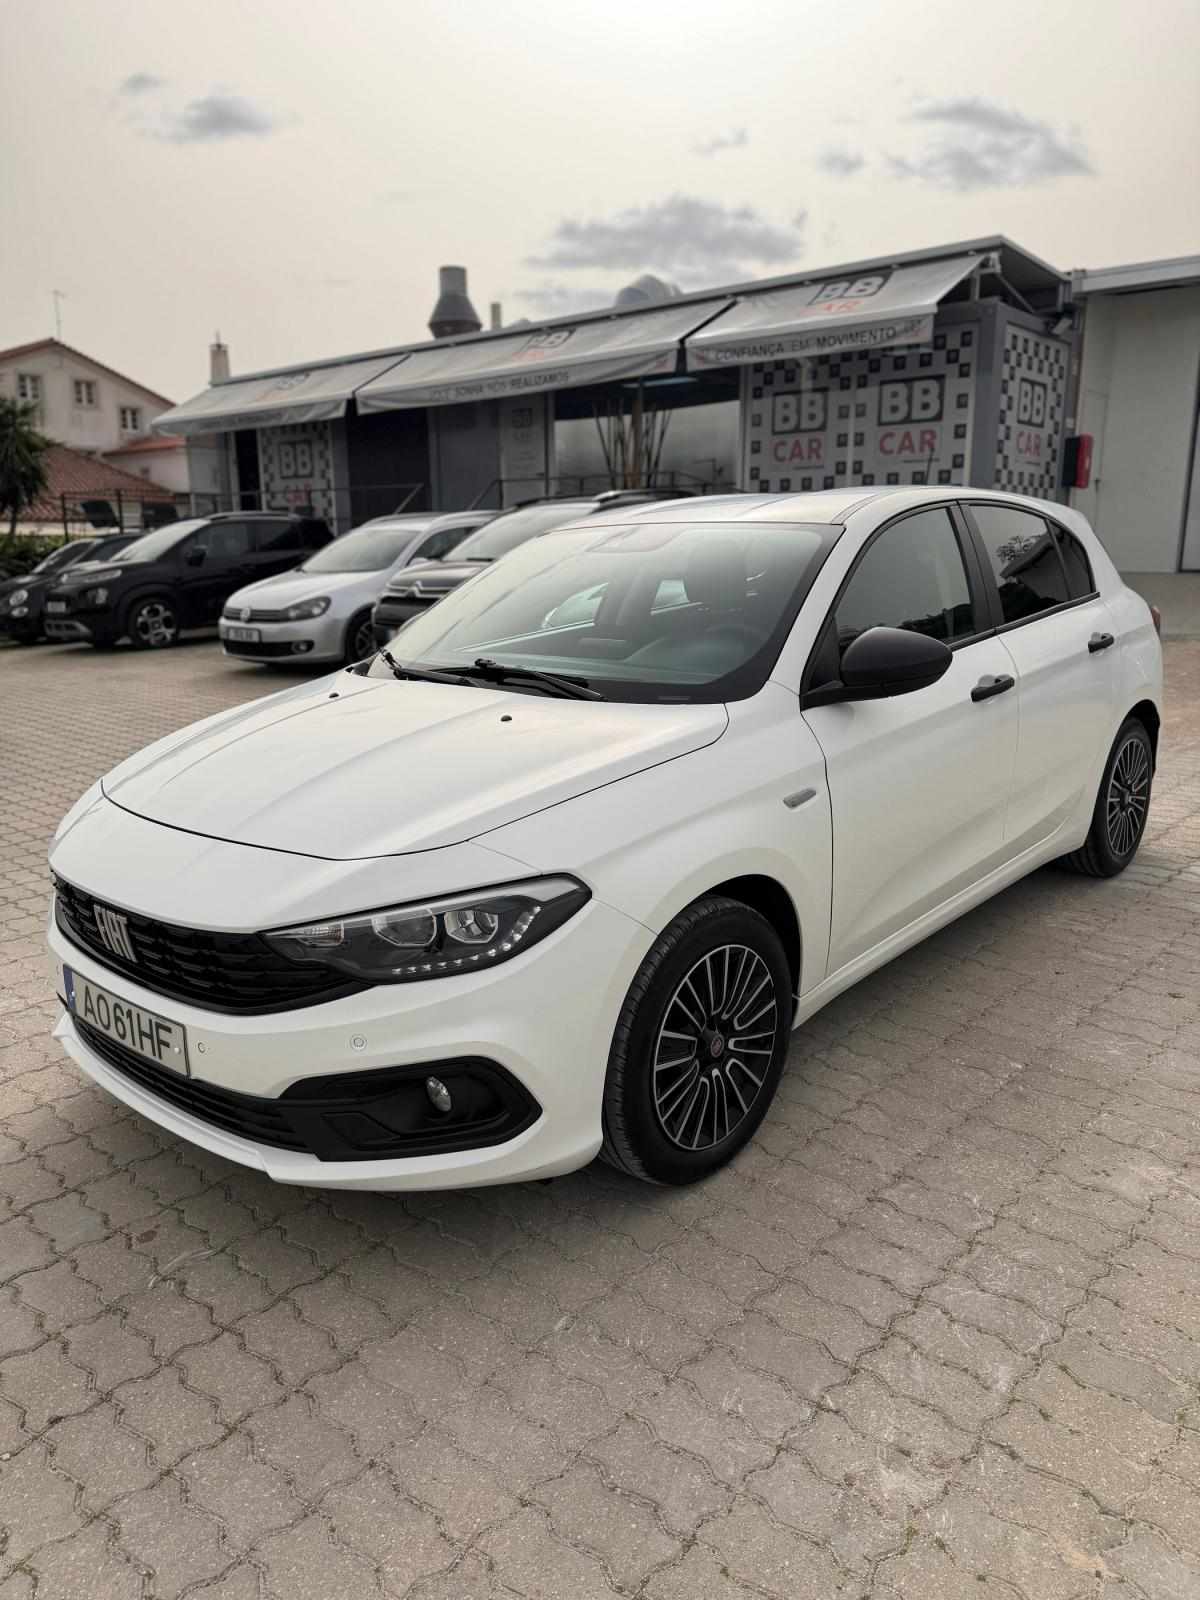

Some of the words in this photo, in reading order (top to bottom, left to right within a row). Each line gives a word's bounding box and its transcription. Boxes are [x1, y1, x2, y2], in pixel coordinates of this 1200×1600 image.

[812, 276, 885, 303] BB
[816, 326, 897, 347] MOVIMENTO
[774, 391, 826, 433] BB
[878, 377, 942, 424] BB
[1019, 381, 1045, 426] BB
[280, 442, 312, 478] BB
[772, 437, 823, 463] CAR
[879, 429, 937, 455] CAR
[1017, 431, 1041, 457] CAR
[93, 904, 138, 963] FIAT
[84, 984, 172, 1060] AO61HF
